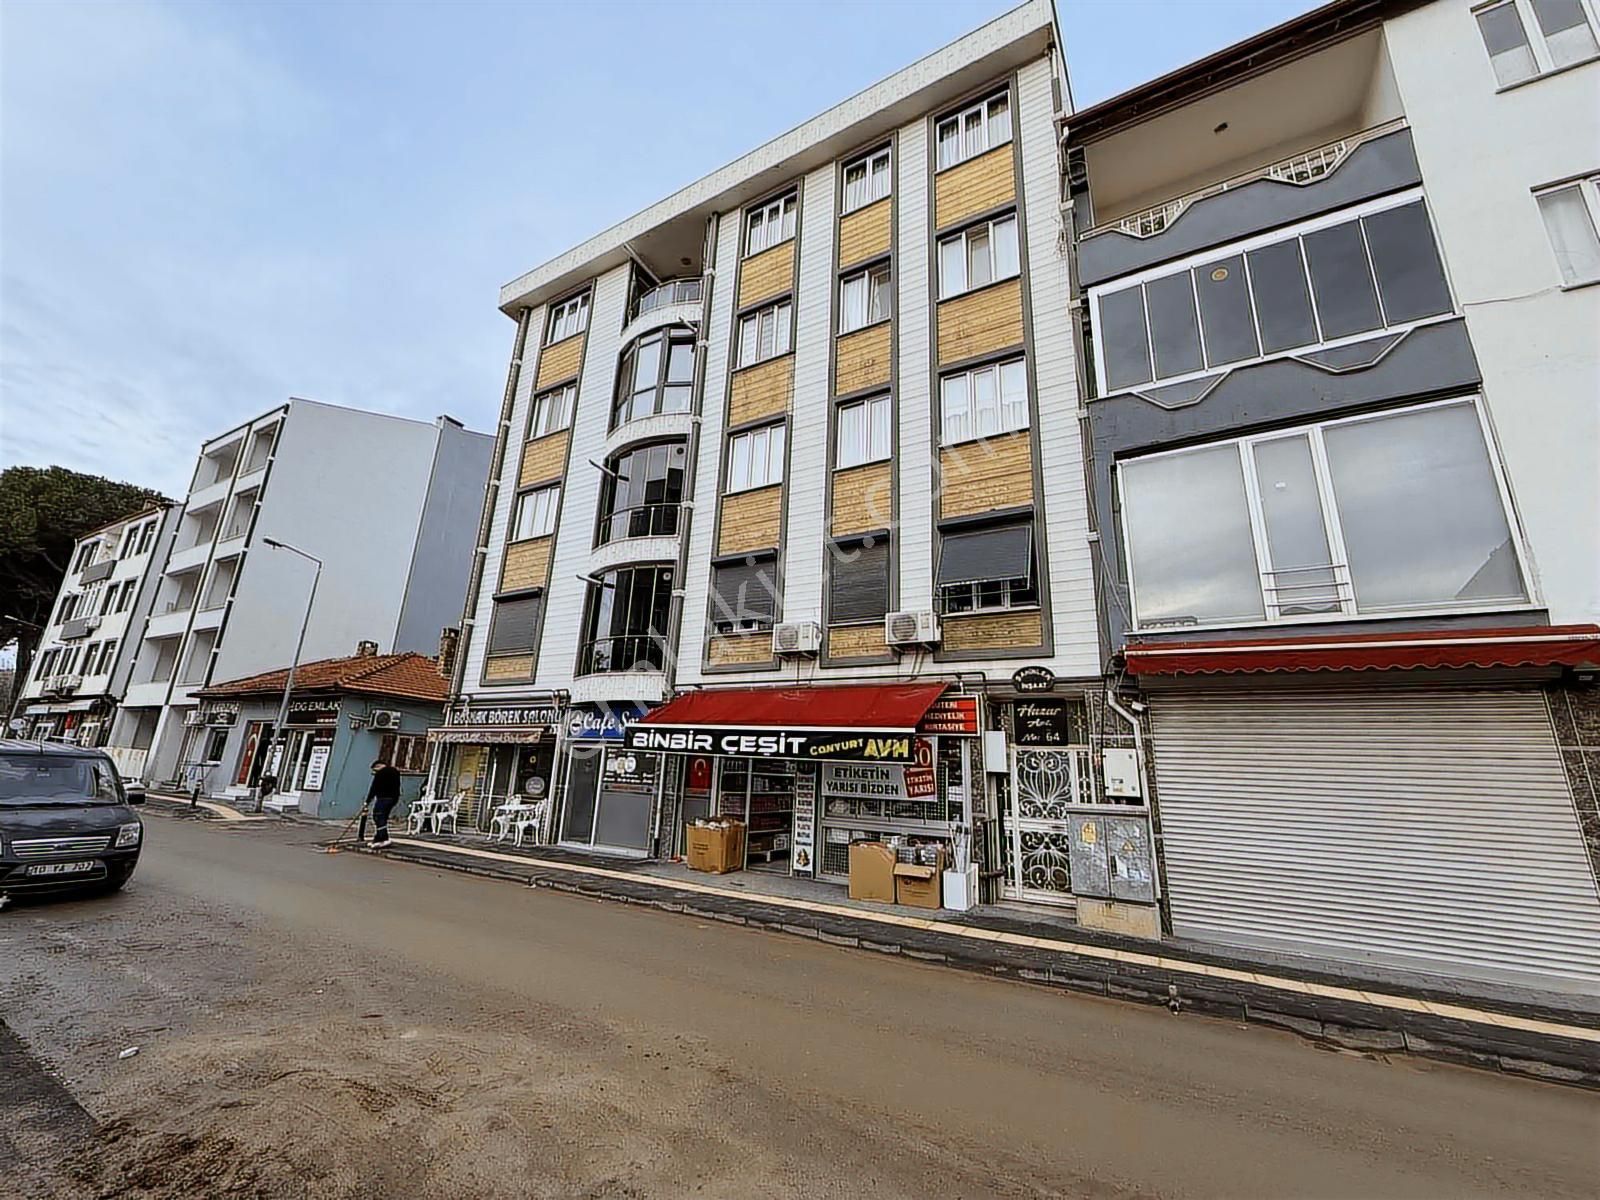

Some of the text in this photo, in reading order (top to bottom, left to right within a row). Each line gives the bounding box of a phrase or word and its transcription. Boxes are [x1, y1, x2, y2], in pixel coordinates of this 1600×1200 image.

[488, 708, 521, 724] BÖREK
[583, 711, 616, 735] Cafe
[632, 729, 713, 751] BİNBİR
[720, 732, 808, 757] ÇEŞİT
[864, 738, 909, 758] AVM
[833, 766, 890, 781] ETİKETİN
[825, 782, 899, 796] YARISI BİZDEN
